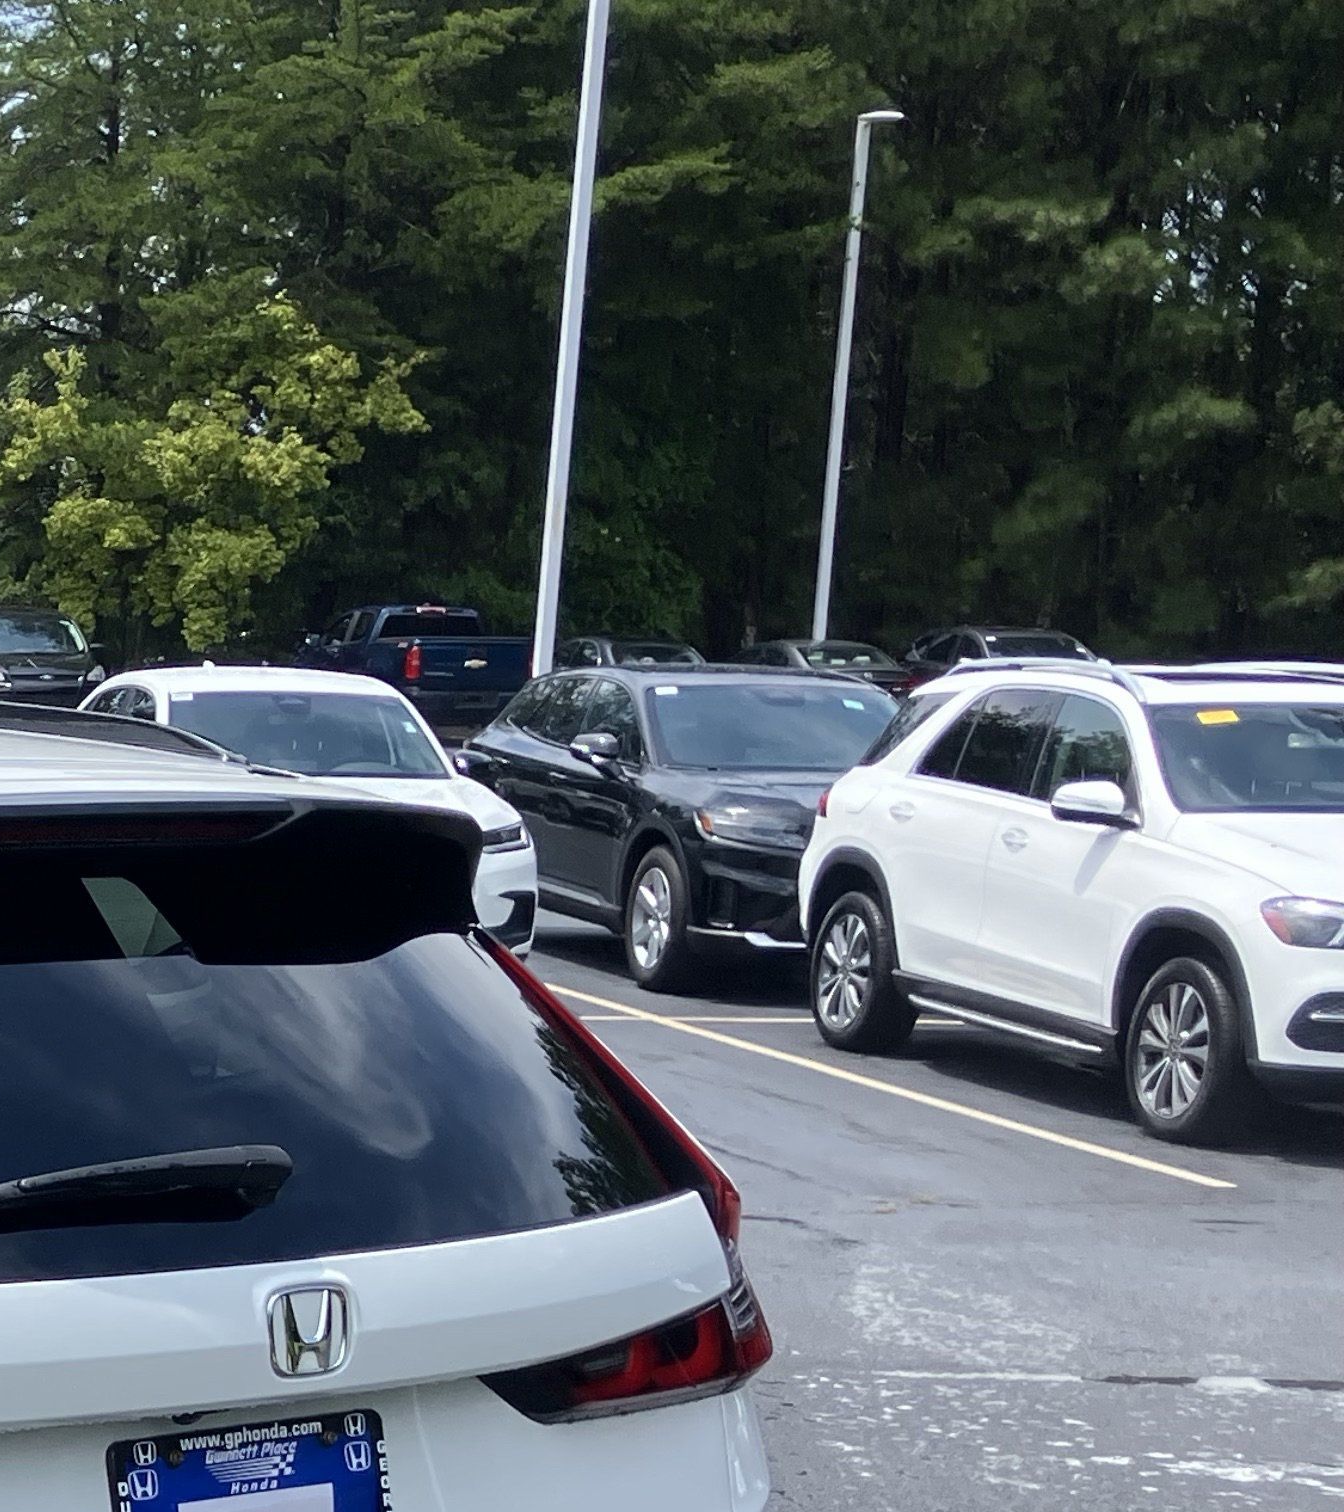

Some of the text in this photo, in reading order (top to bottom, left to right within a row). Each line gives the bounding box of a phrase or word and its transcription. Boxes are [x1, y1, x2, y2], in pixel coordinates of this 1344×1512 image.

[180, 1421, 323, 1451] www.gphonda.com
[205, 1441, 298, 1465] Gwinnett Place
[230, 1478, 279, 1495] Honda
